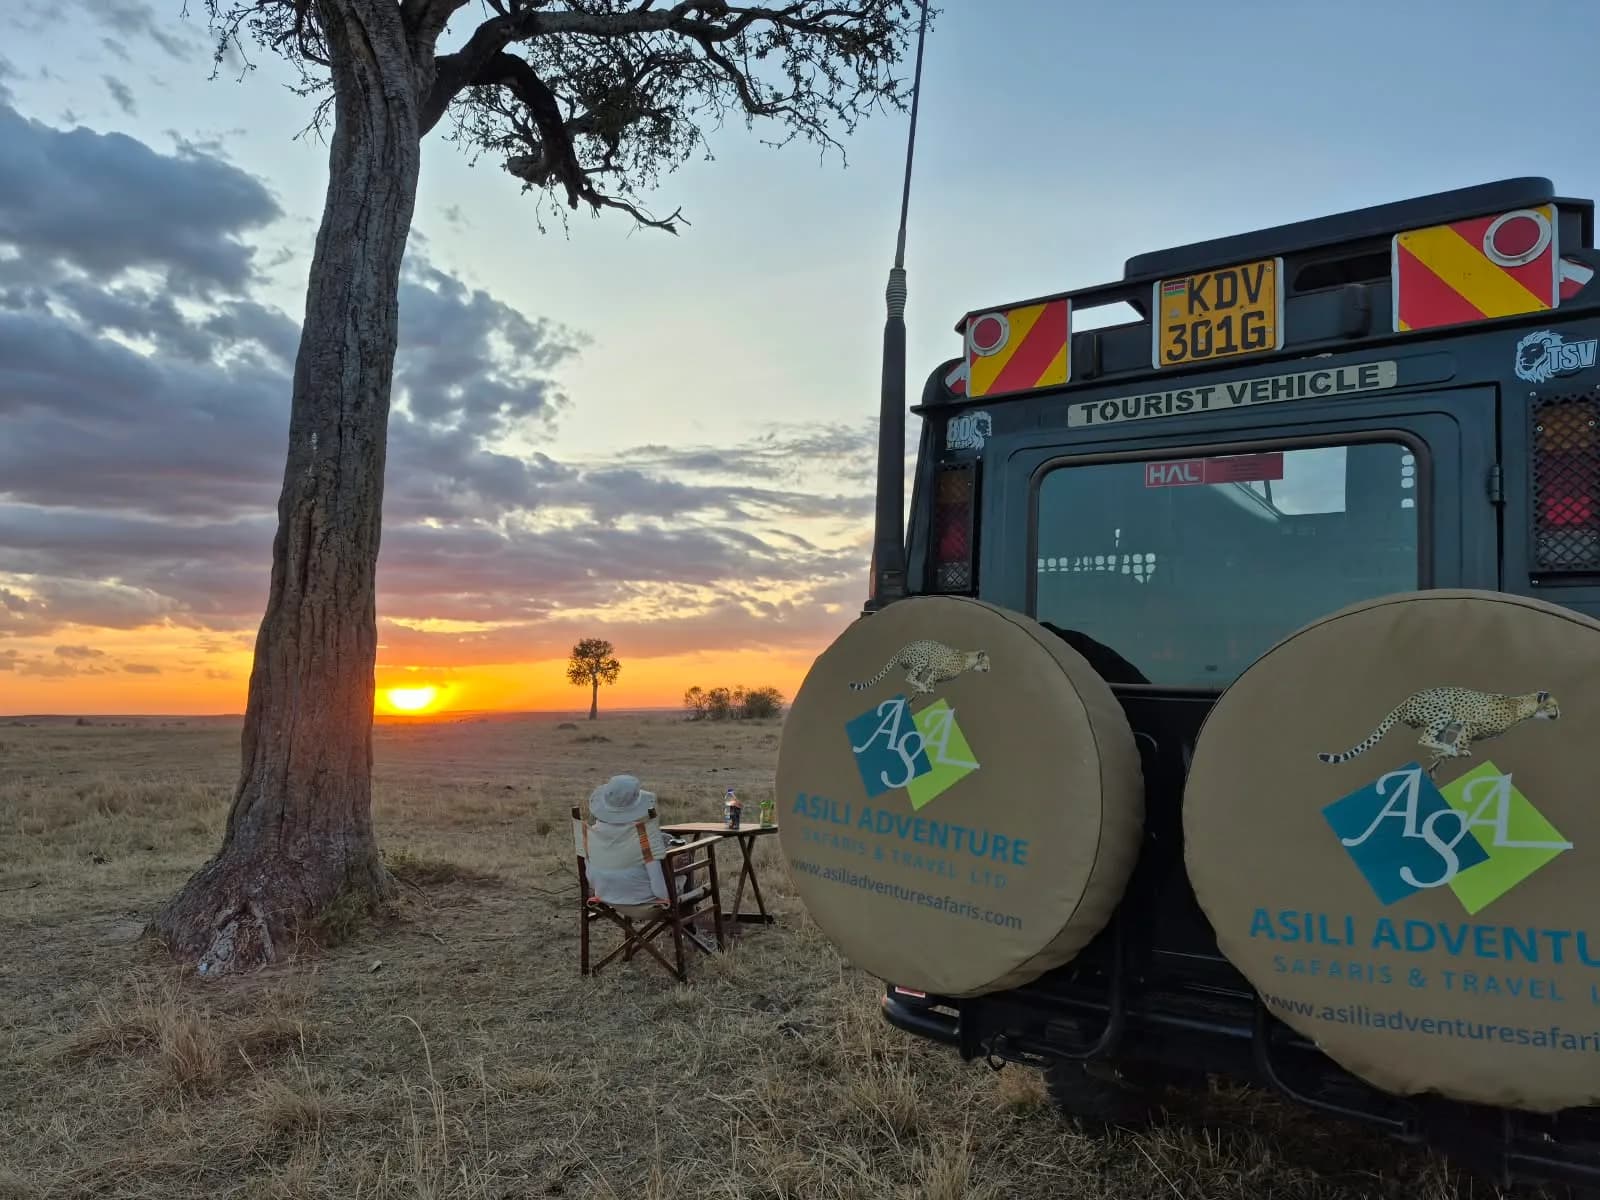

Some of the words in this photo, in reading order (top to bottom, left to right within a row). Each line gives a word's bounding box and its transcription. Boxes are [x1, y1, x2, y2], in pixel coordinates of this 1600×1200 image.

[1188, 264, 1265, 315] KDV
[1166, 310, 1266, 362] 301G
[1546, 341, 1596, 371] TSV
[1081, 387, 1216, 424] TOURIST
[1226, 365, 1380, 405] VEHICLE
[1150, 463, 1199, 484] HAL
[792, 792, 851, 825] ASILI
[858, 806, 1030, 865] ADVENTURE
[803, 827, 865, 856] SAFARIS
[873, 845, 885, 863] &
[893, 849, 957, 879] TRAVEL
[971, 865, 1008, 890] LTD
[791, 857, 1023, 930] www.asiliadventuresafaris.com
[1250, 907, 1355, 946] ASILI
[1371, 917, 1600, 968] ADVENTU
[1274, 954, 1393, 985] SAFARIS
[1408, 968, 1426, 989] &
[1442, 970, 1565, 1003] TRAVEL
